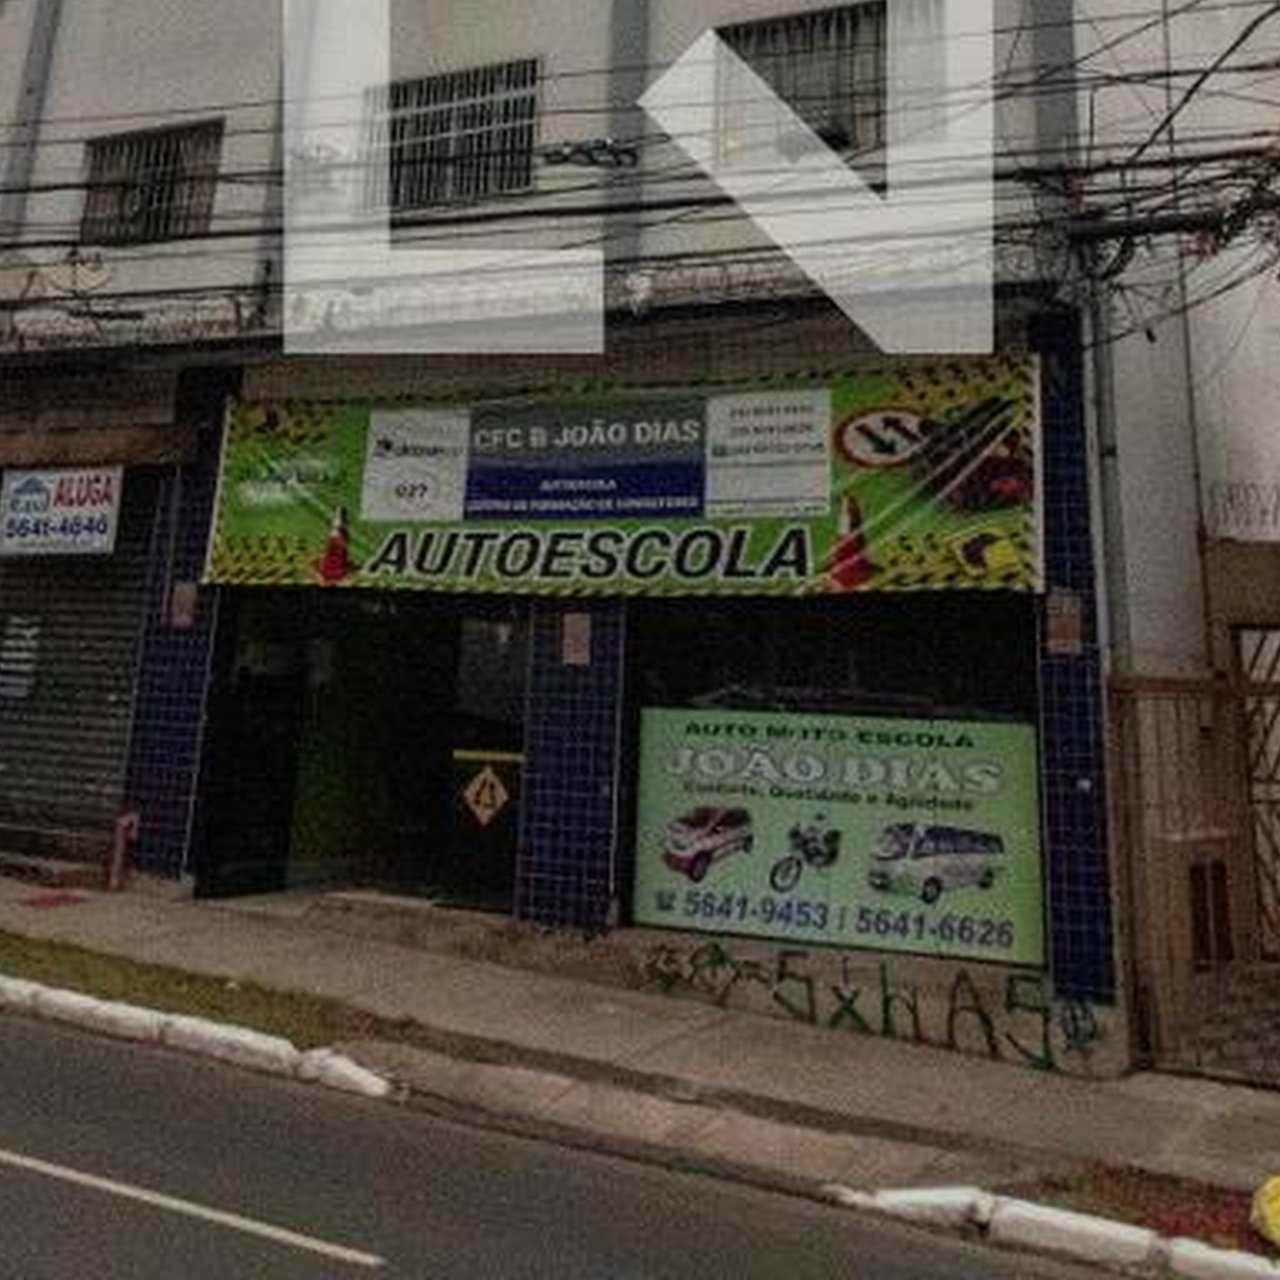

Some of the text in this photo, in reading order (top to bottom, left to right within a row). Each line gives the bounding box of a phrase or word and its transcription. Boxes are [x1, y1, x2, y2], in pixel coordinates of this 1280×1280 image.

[475, 426, 523, 449] CFC
[554, 419, 628, 447] JOÃO
[634, 419, 700, 444] DIAS
[53, 476, 113, 508] ALUGA
[369, 526, 811, 583] AUTOESCOLA
[685, 722, 757, 738] AUTO
[857, 730, 974, 749] ESCOLA
[666, 744, 1005, 796] JOÃO DIAS
[684, 891, 830, 931] 5641-9453
[855, 907, 1015, 949] 5641-6626
